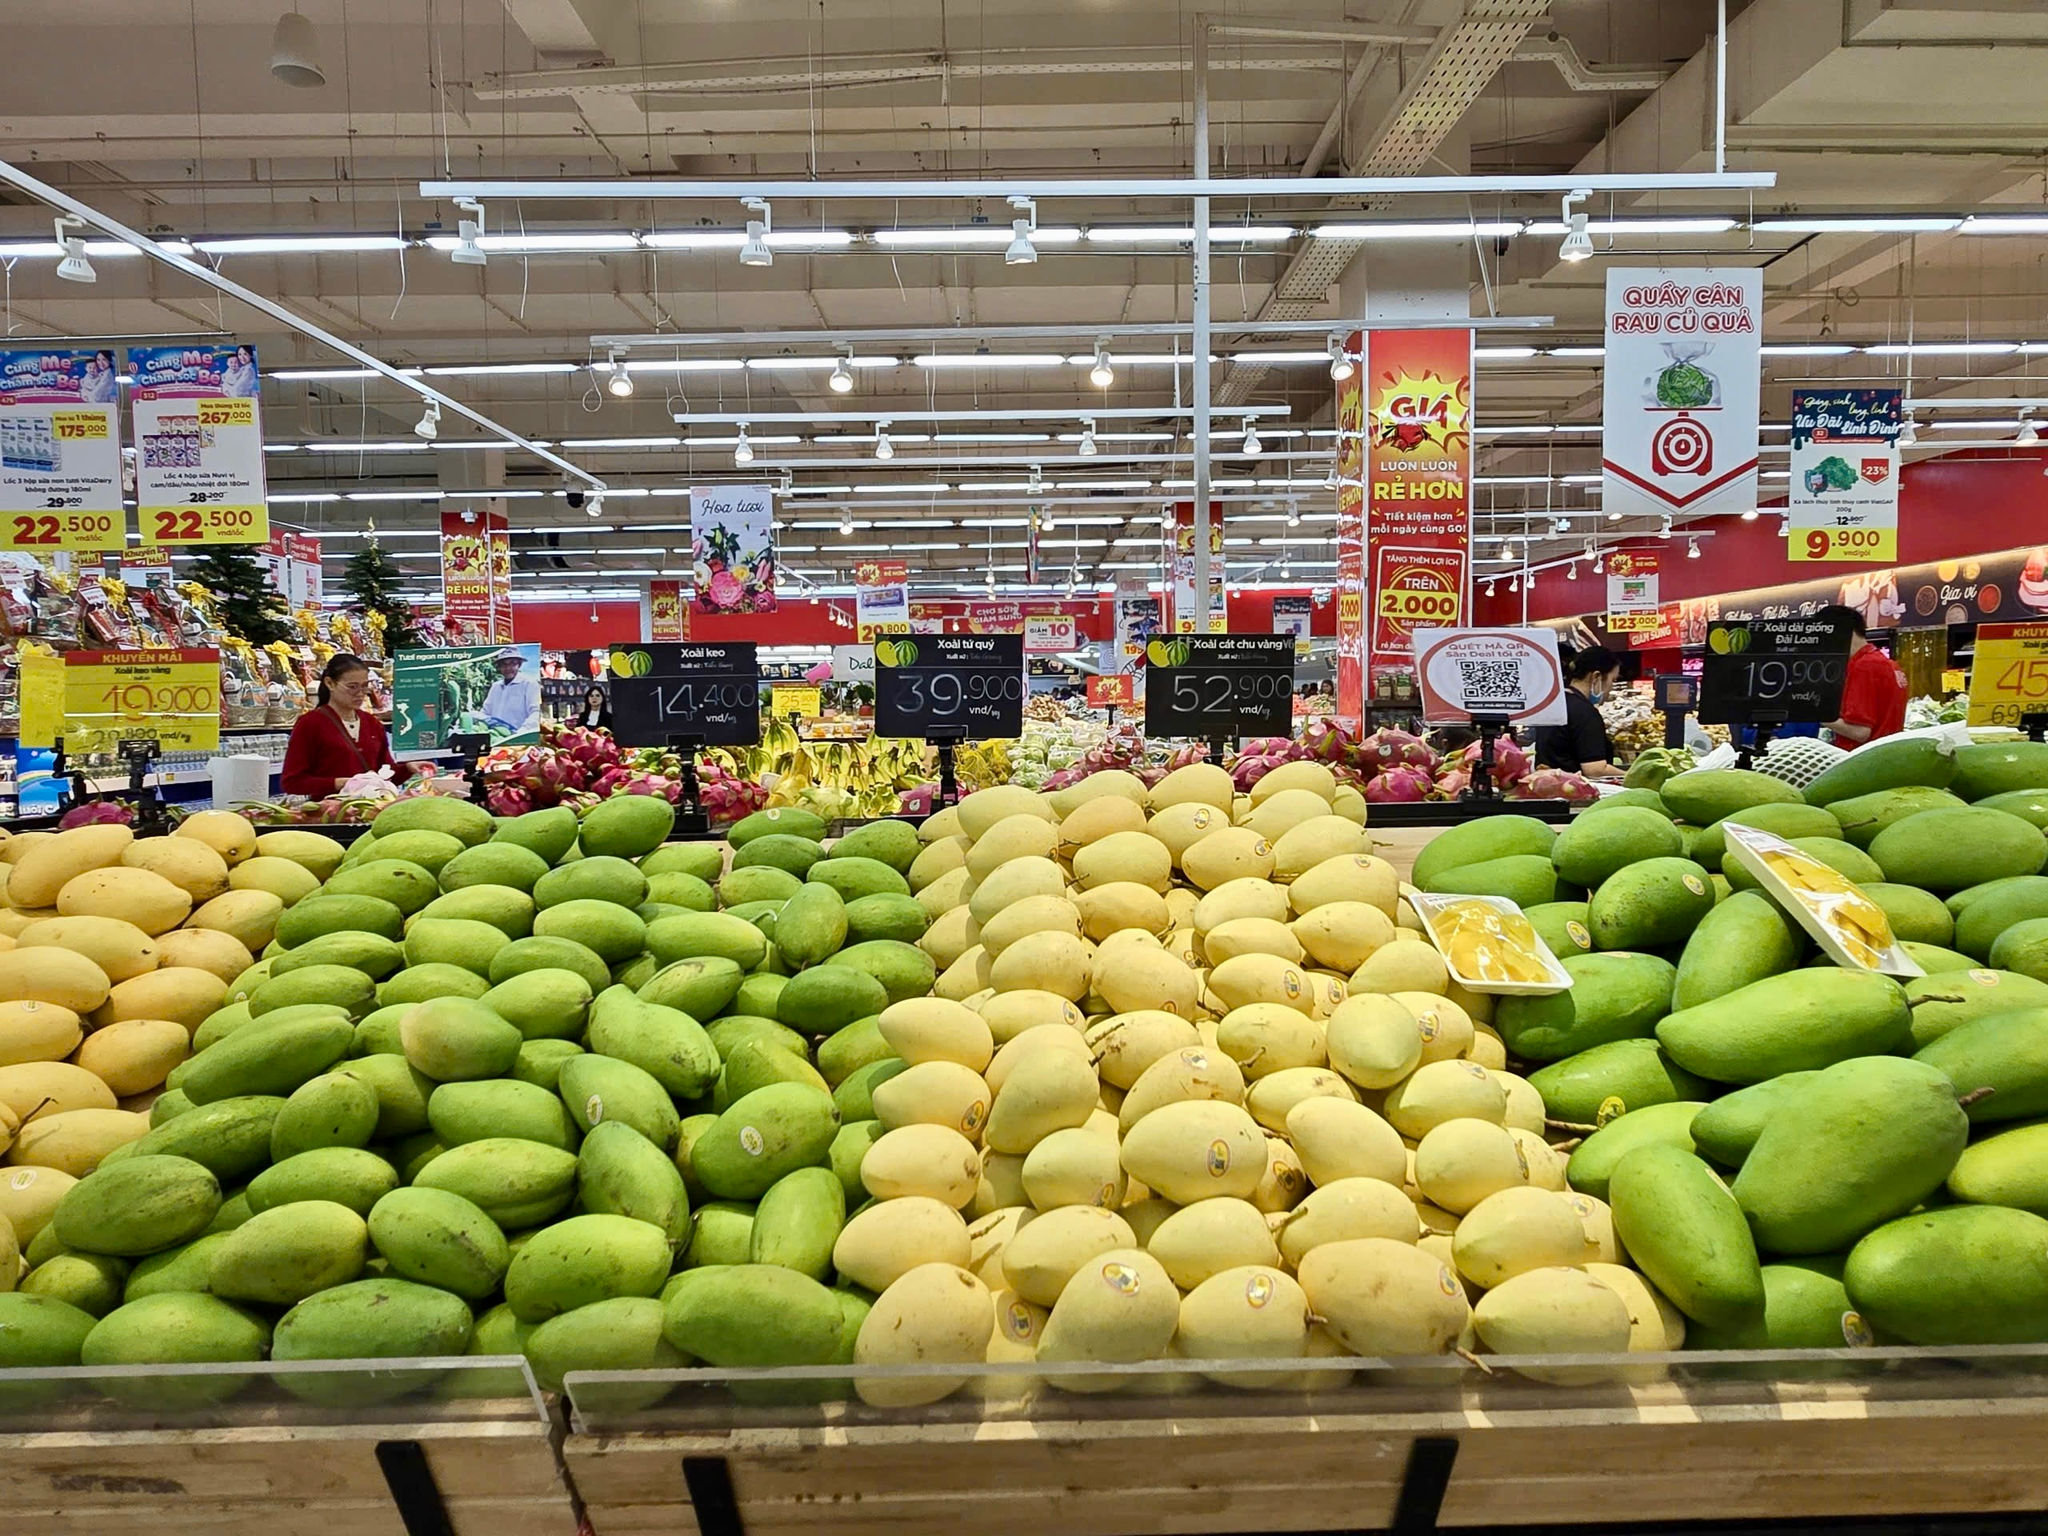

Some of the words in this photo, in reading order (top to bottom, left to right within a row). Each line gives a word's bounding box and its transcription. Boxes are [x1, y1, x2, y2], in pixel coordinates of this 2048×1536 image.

[1694, 283, 1743, 305] CÂN
[1613, 312, 1661, 333] RAU
[1665, 308, 1698, 333] CỦ
[1703, 307, 1754, 332] QUẢ
[41, 355, 71, 373] Mẹ
[182, 350, 213, 368] Mẹ
[56, 374, 79, 390] Bé
[199, 369, 221, 386] Bé
[82, 414, 106, 422] thùng
[200, 411, 252, 424] 267.000
[1390, 394, 1452, 429] GIÁ
[59, 424, 107, 437] 175.000
[1381, 459, 1417, 471] LUÔN
[1421, 459, 1457, 470] LUÔN
[1863, 466, 1888, 476] -23%
[1374, 476, 1405, 499] RẺ
[1410, 481, 1463, 499] HƠN
[701, 499, 732, 516] Hoa
[737, 500, 764, 513] tươi
[1384, 511, 1404, 520] Tiết
[1407, 512, 1431, 521] kiệm
[1434, 512, 1453, 520] hơn
[13, 516, 111, 544] 22.500
[155, 511, 253, 539] 22.500
[1371, 523, 1390, 533] mỗi
[1393, 525, 1417, 534] ngày
[1420, 524, 1444, 534] cùng
[1447, 524, 1466, 532] GO!
[452, 546, 480, 558] GIÁ
[1807, 530, 1880, 558] 9.900
[1409, 556, 1429, 564] THÊM
[446, 582, 461, 594] RẺ
[463, 585, 488, 594] HƠN
[1404, 576, 1438, 590] TRÊN
[1941, 585, 1962, 605] Gia
[1964, 584, 1977, 601] vị
[1383, 595, 1455, 615] 2.000
[1611, 617, 1656, 629] 123.000
[1764, 623, 1786, 632] Xoài
[1788, 622, 1803, 632] dài
[1805, 622, 1834, 633] giống
[938, 640, 960, 649] Xoài
[963, 640, 974, 649] tứ
[975, 640, 995, 650] quý
[1194, 639, 1217, 649] Xoài
[1219, 640, 1234, 649] cát
[1237, 639, 1256, 649] chu
[1257, 640, 1282, 651] vàng
[1775, 635, 1792, 644] Đài
[1794, 635, 1819, 644] Loan
[102, 651, 154, 663] KHUYẾN
[158, 653, 182, 662] MÃI
[681, 648, 704, 658] Xoài
[706, 648, 725, 657] keo
[1744, 661, 1842, 699] 19.900
[896, 674, 1020, 715] 39.900
[1172, 675, 1293, 712] 52.900
[102, 685, 211, 721] 19.900
[649, 684, 756, 722] 14.400
